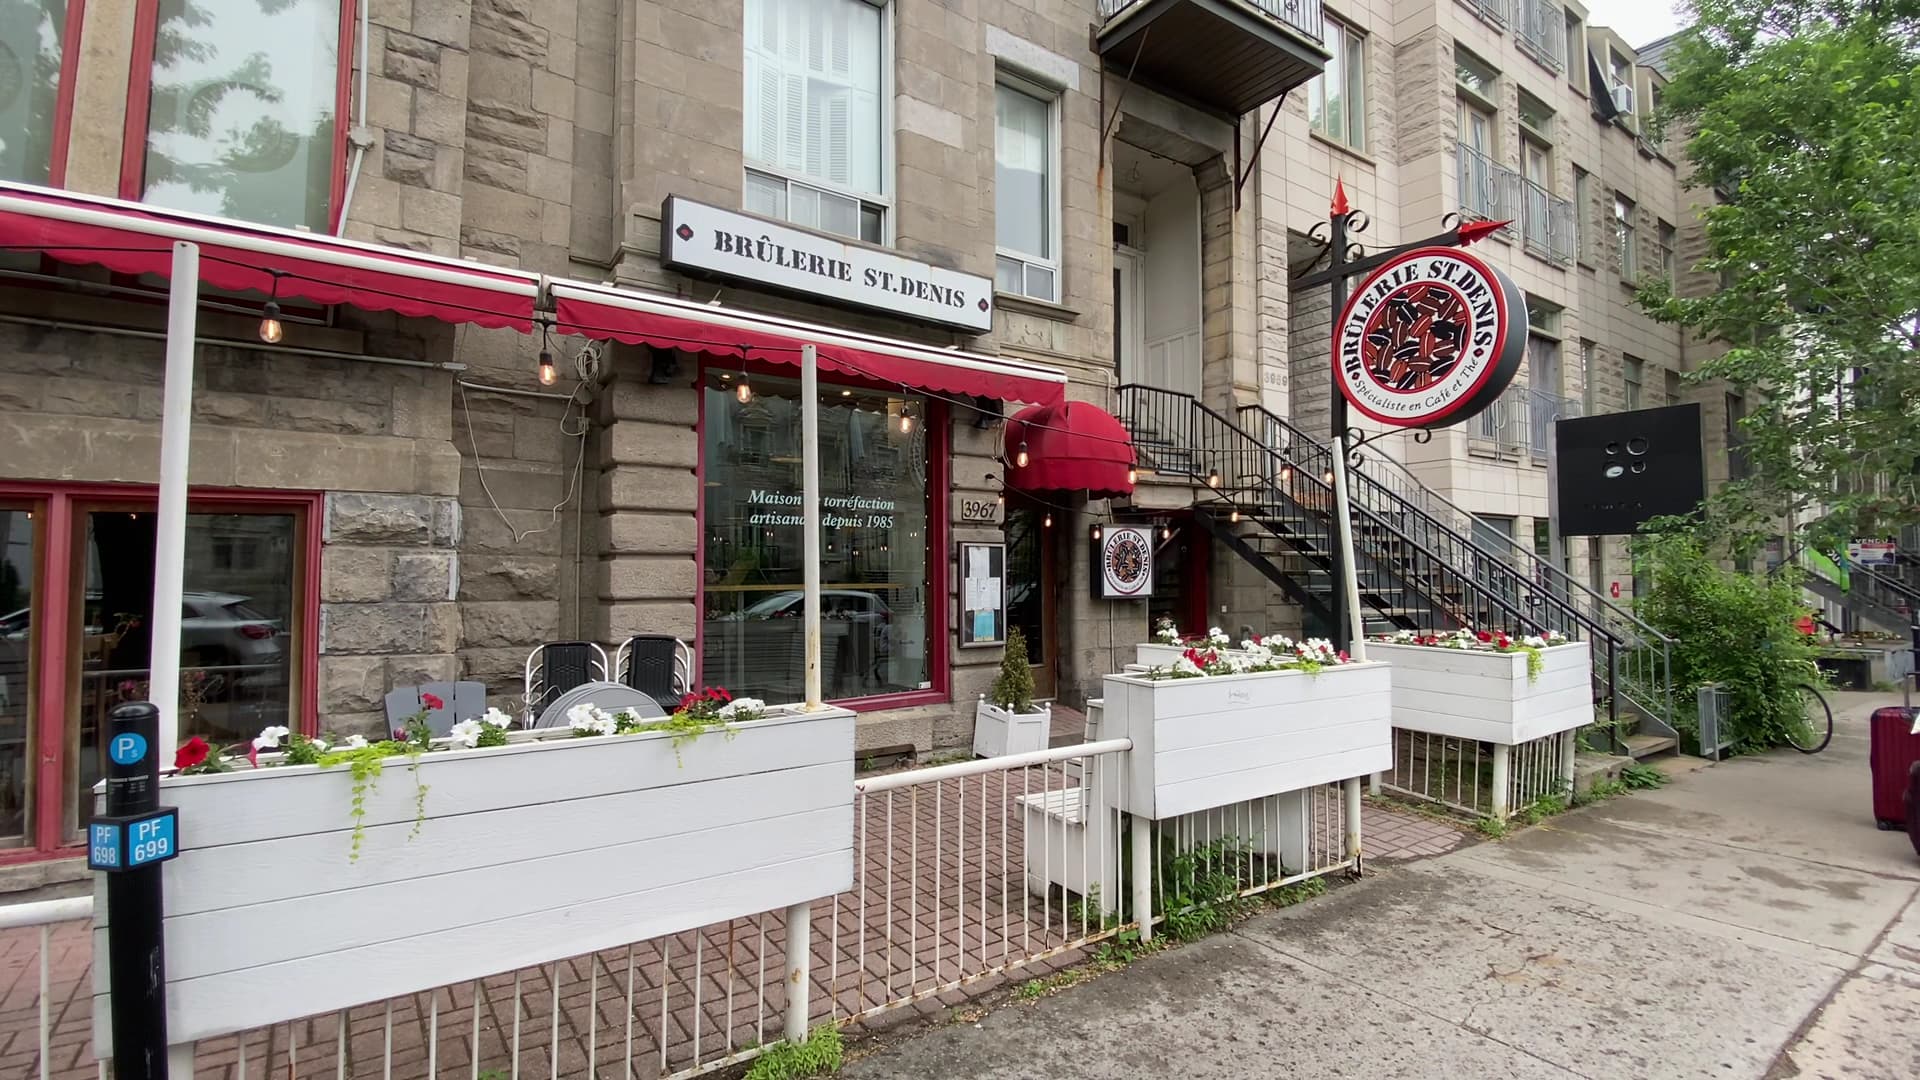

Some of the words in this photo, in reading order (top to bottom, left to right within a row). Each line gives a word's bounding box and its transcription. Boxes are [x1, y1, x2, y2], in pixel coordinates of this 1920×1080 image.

[714, 229, 852, 282] BRÛLERIE
[864, 268, 966, 308] ST.DENIS
[1344, 263, 1419, 374] BRÛLERIE
[1428, 260, 1495, 347] ST.DENIS
[1354, 380, 1406, 411] Spécialiste
[1409, 402, 1422, 411] en
[1425, 387, 1450, 408] Café
[1452, 379, 1462, 392] et
[748, 490, 802, 505] Maison
[824, 495, 894, 510] torréfaction
[964, 502, 997, 518] 3967
[822, 513, 863, 529] depuis
[866, 515, 894, 528] 1985
[96, 826, 111, 844] PF
[139, 819, 160, 840] PF
[94, 847, 116, 864] 698
[135, 838, 168, 861] 699
